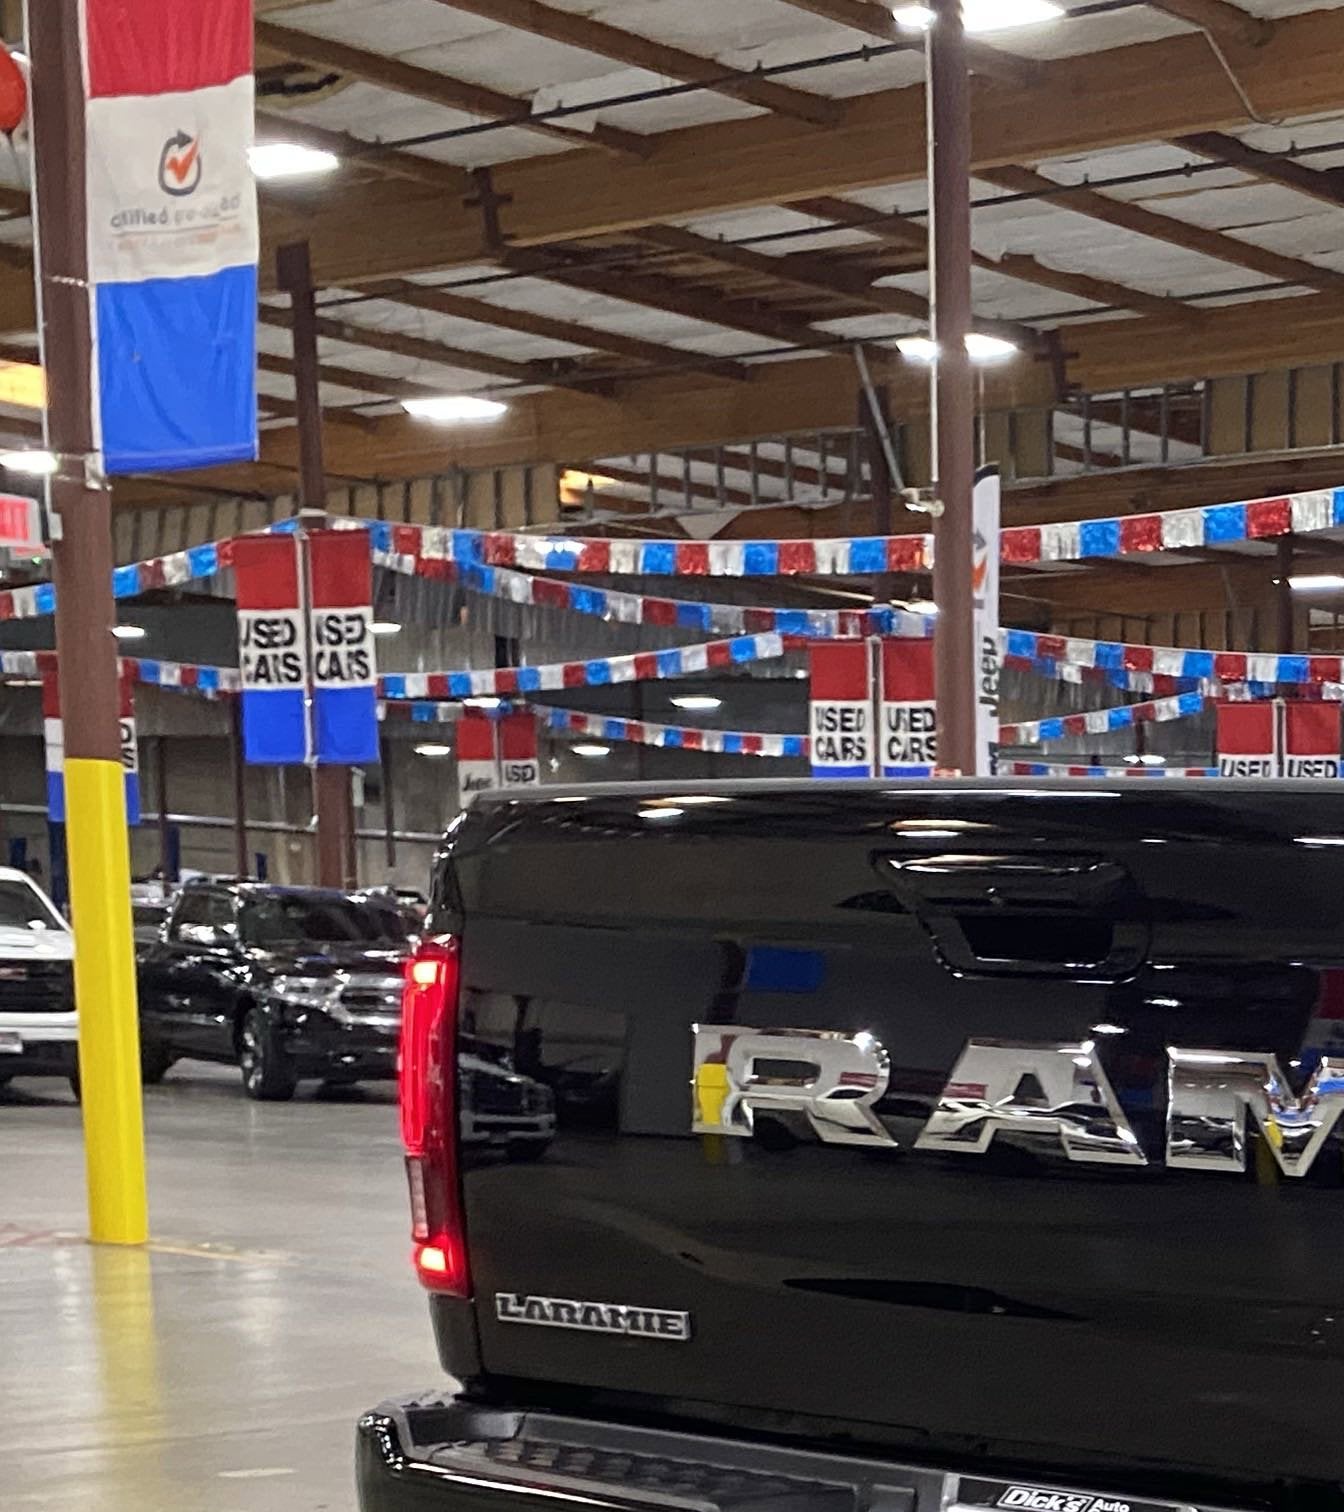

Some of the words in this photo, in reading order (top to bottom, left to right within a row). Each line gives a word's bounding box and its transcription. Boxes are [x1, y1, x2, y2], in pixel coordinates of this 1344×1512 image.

[979, 636, 1000, 718] Jeep
[815, 706, 865, 732] USED
[815, 736, 866, 761] CARS
[1288, 759, 1338, 778] USED
[496, 1292, 690, 1340] LARAMIE
